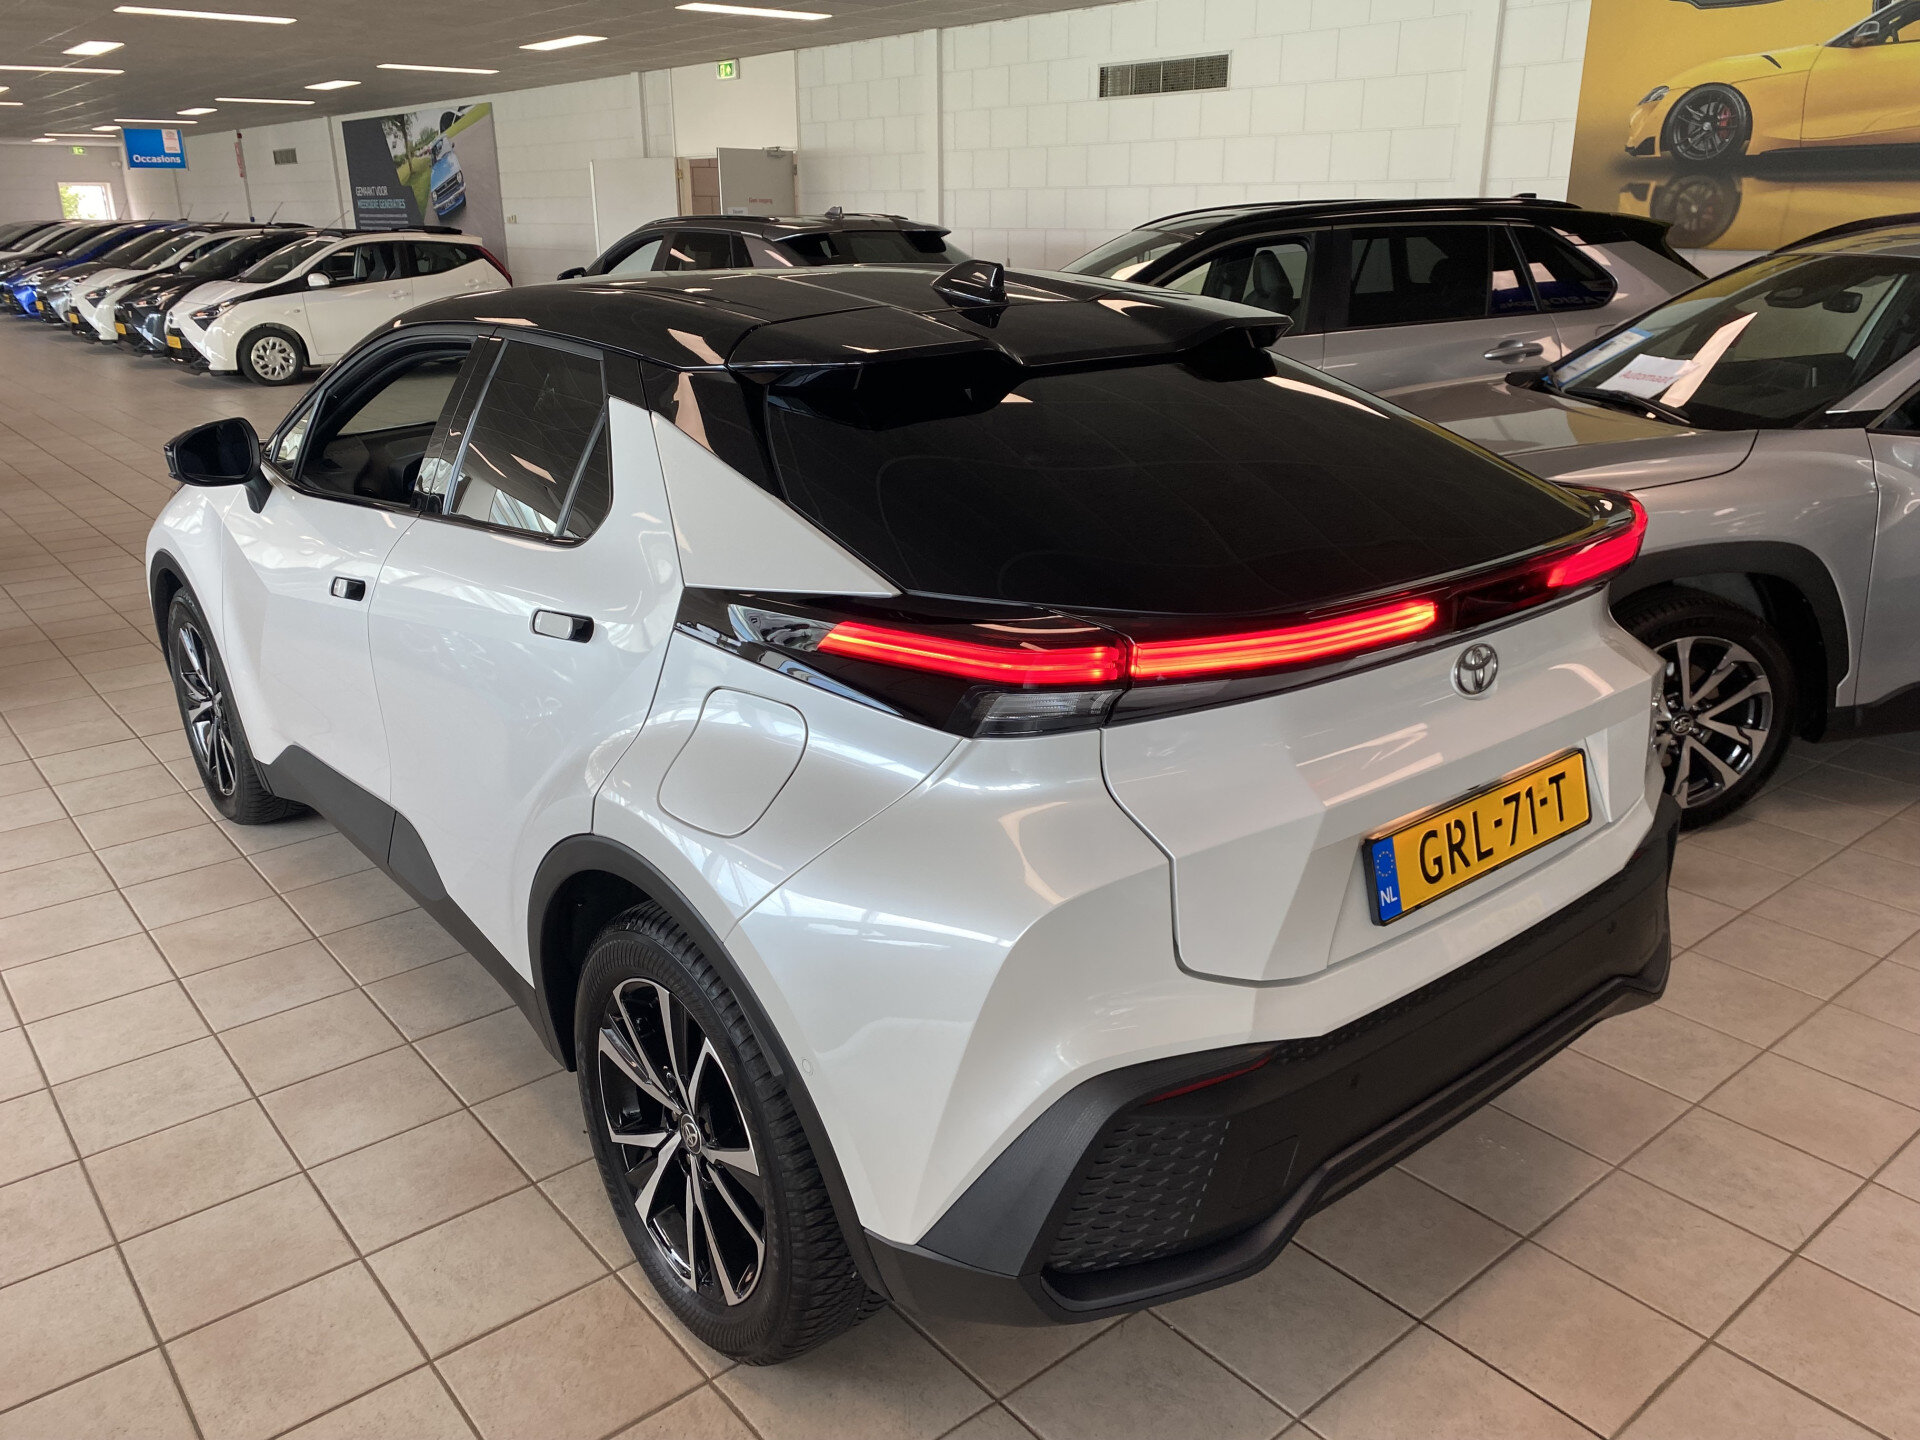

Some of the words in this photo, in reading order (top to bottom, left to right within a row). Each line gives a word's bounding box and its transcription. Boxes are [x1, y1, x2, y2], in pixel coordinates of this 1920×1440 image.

[133, 154, 181, 163] Occasions
[1620, 370, 1674, 384] Automaat
[1419, 771, 1566, 885] GRL-71-T
[1380, 886, 1398, 907] NL
